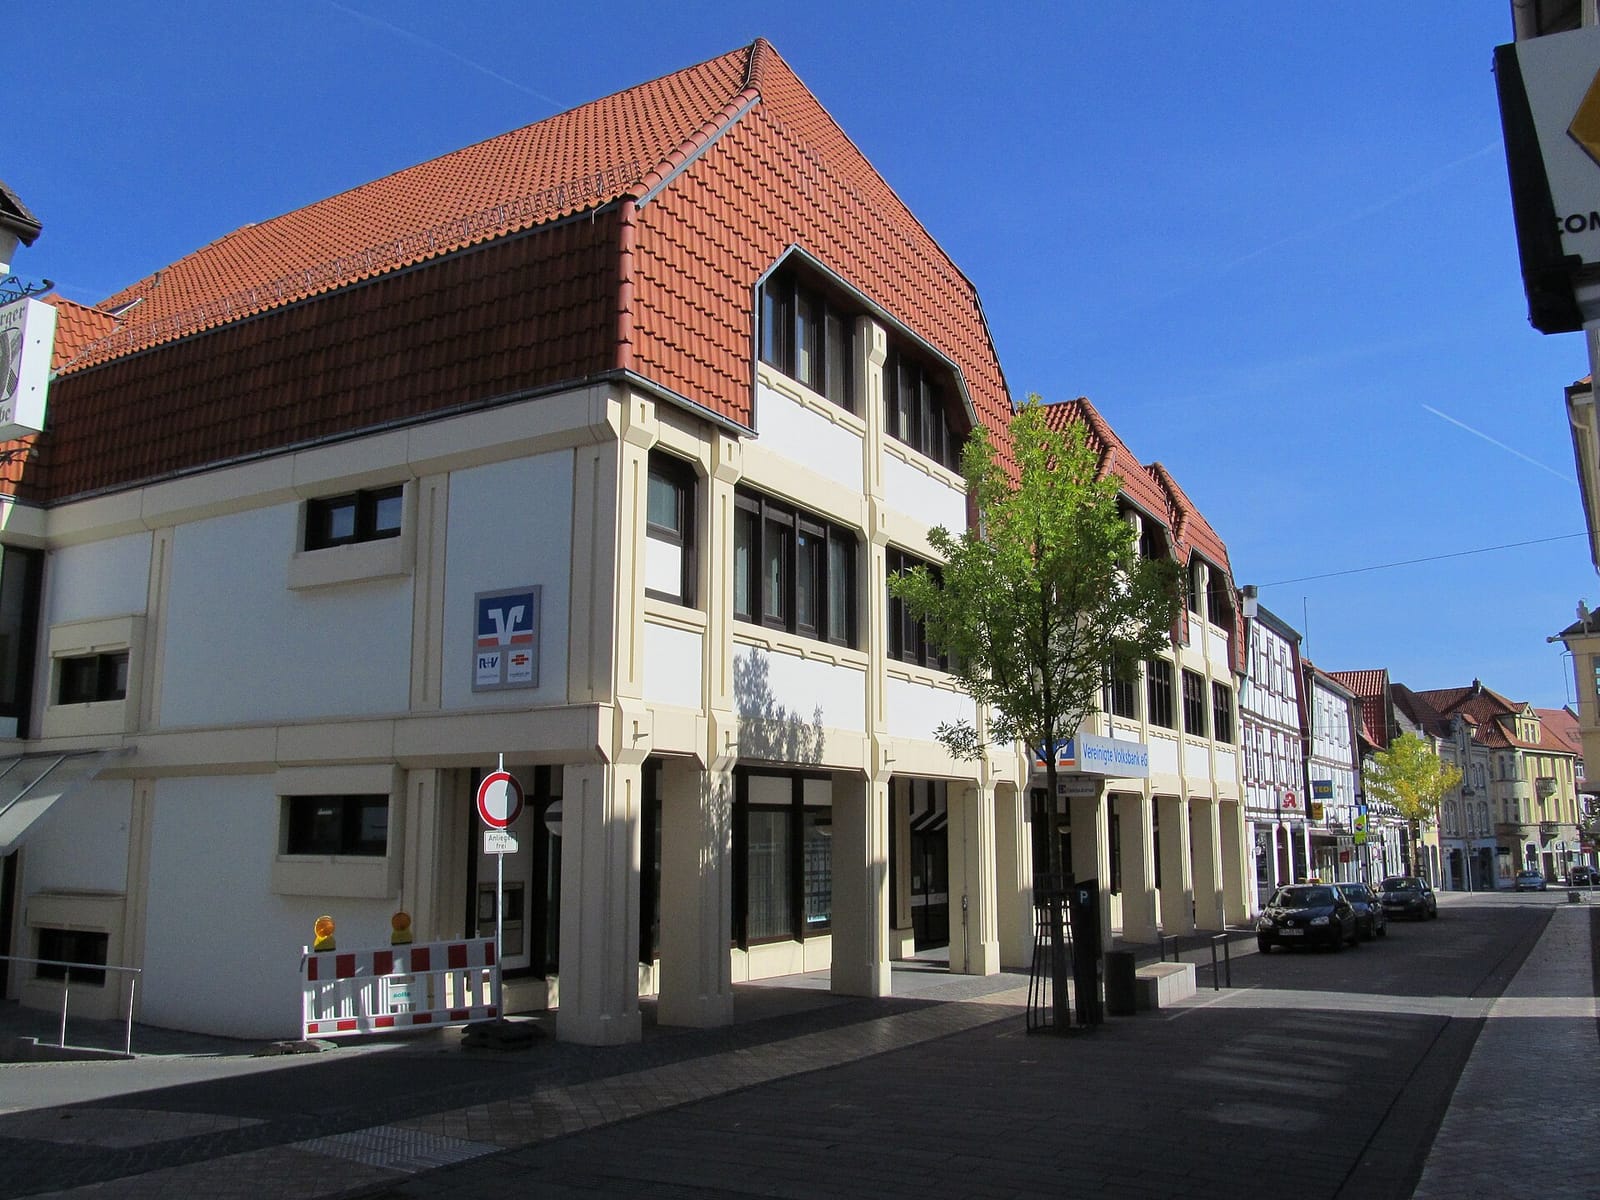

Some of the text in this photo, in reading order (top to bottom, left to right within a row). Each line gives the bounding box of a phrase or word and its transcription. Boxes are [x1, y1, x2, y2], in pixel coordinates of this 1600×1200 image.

[1083, 742, 1148, 767] Vereinigte Volksbank eG
[488, 834, 513, 843] Anliege
[1079, 890, 1088, 904] P
